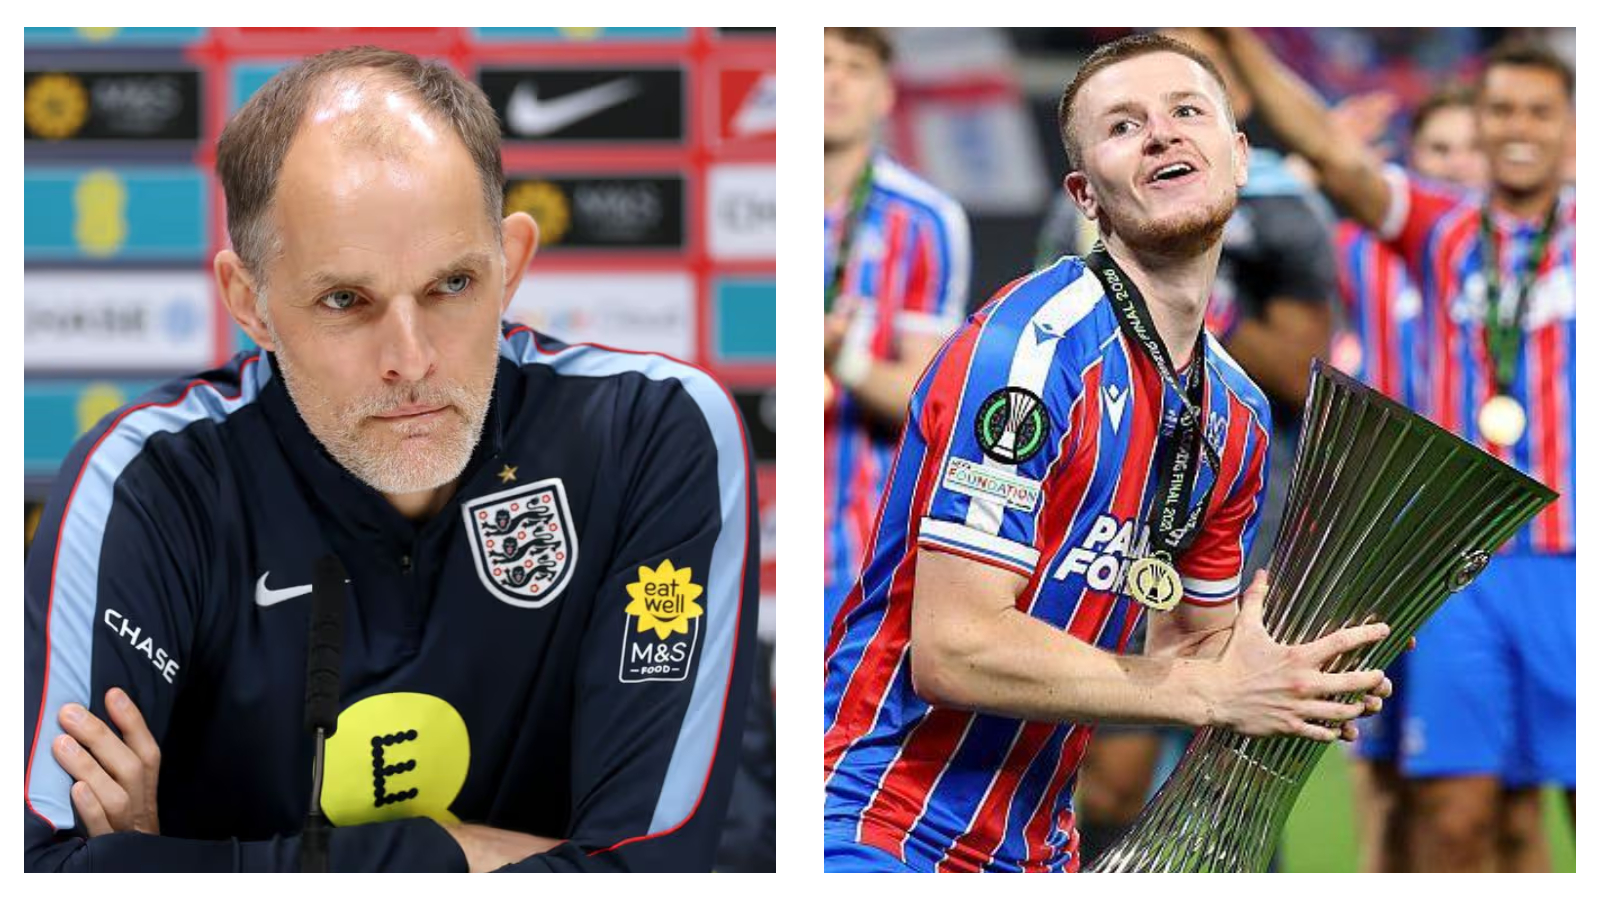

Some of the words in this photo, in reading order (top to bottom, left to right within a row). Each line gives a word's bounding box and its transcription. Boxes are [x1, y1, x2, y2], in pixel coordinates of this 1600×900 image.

[949, 467, 1038, 501] FOUNDATION
[1166, 472, 1185, 503] FINAL
[644, 578, 681, 598] eat
[644, 593, 685, 614] well
[104, 608, 180, 684] CHASE
[630, 641, 688, 665] M&S
[640, 664, 672, 676] FOOD
